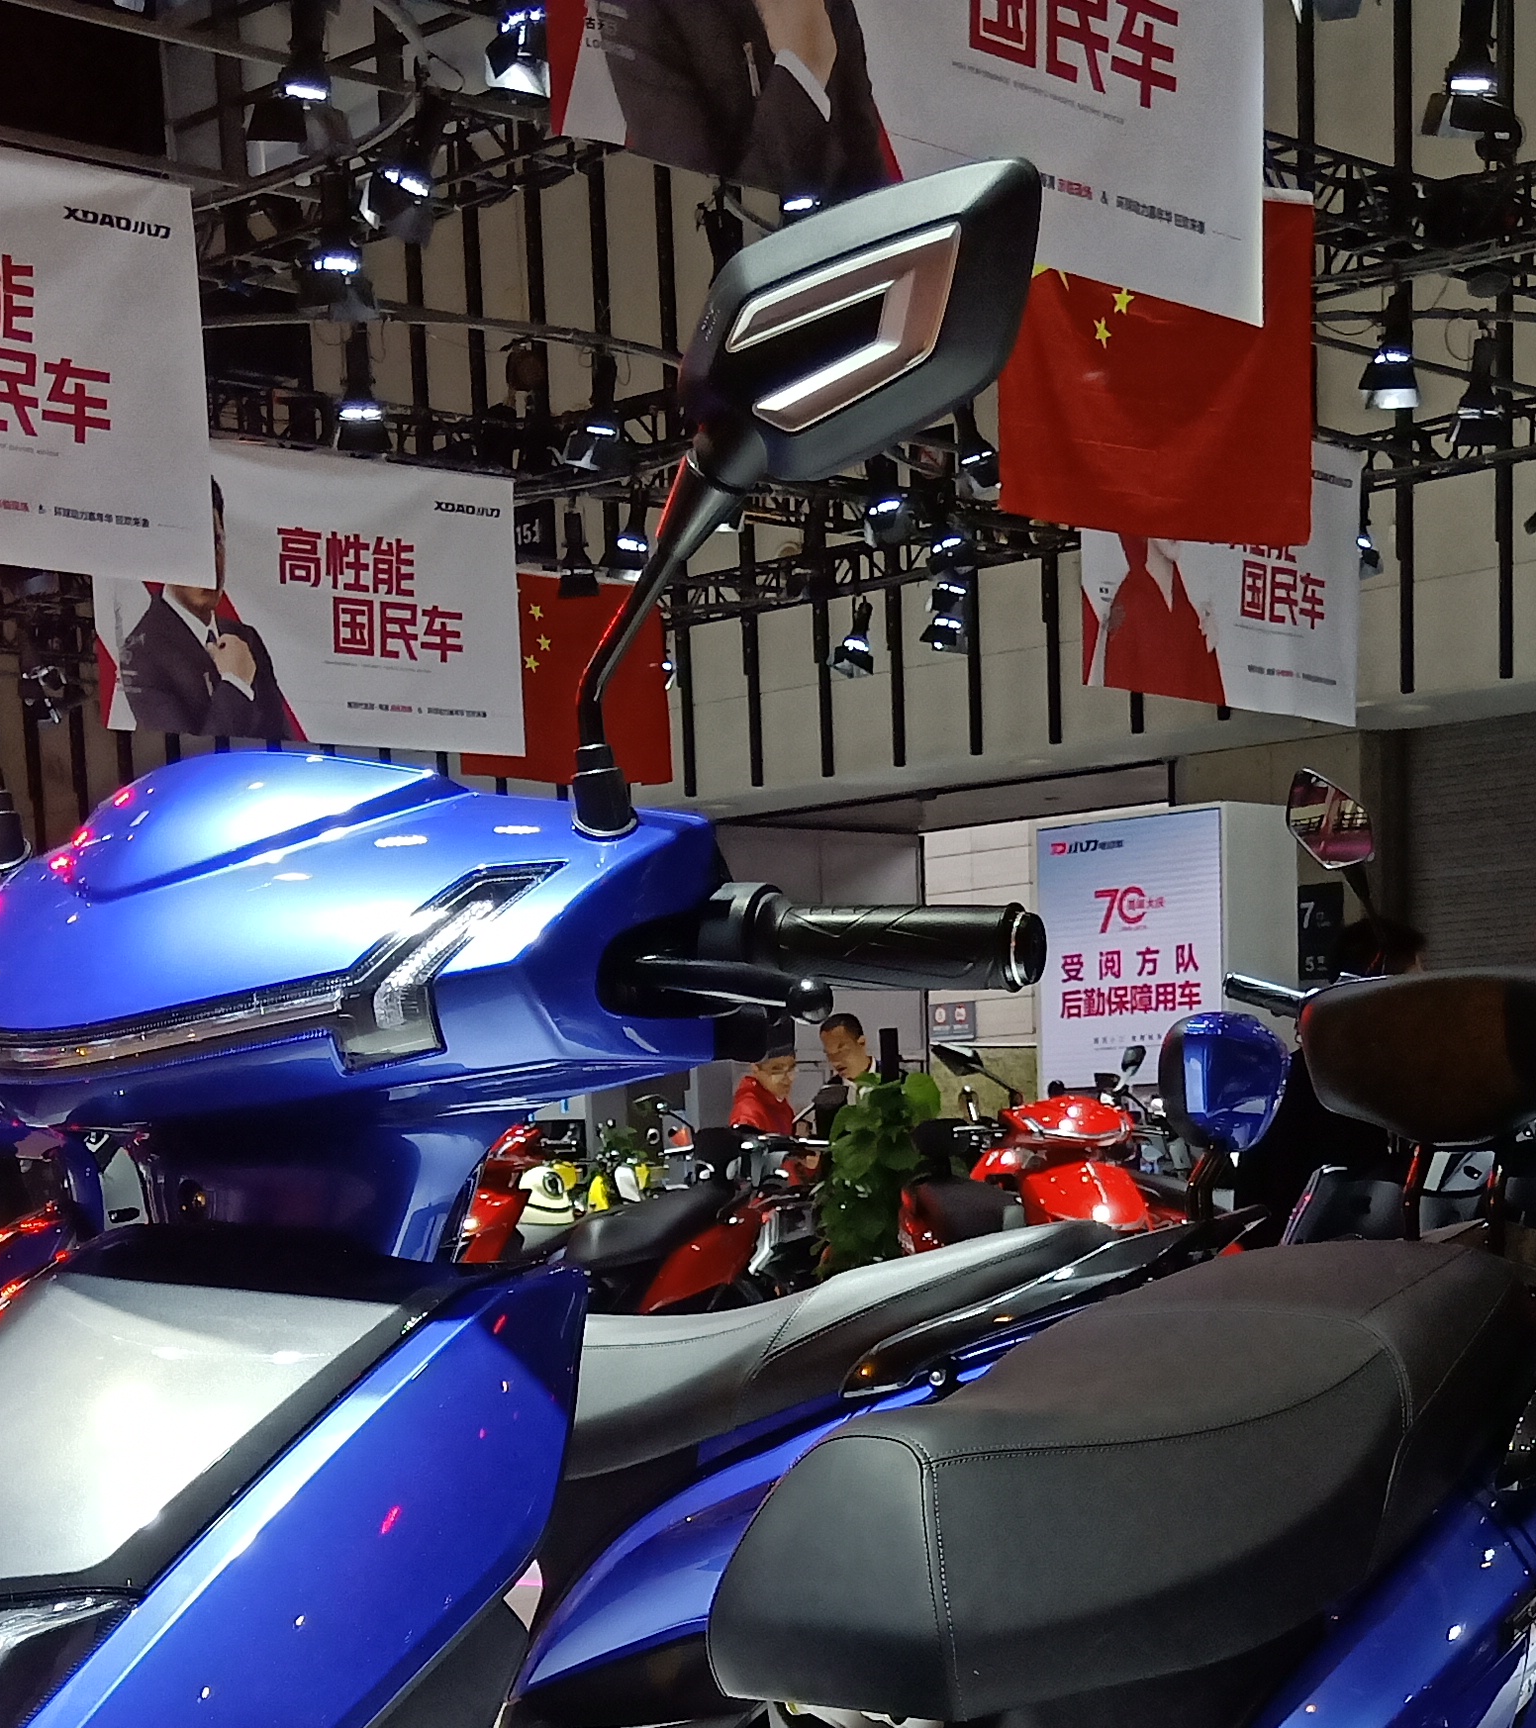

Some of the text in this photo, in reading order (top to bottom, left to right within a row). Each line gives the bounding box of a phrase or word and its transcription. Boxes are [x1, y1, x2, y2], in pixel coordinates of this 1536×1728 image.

[277, 527, 415, 597] 高性能
[1240, 560, 1326, 630] 国民车
[333, 596, 463, 663] 国民车
[1300, 901, 1315, 929] 7
[1061, 943, 1199, 984] 受阅方队
[1060, 980, 1202, 1019] 后勤保障用车
